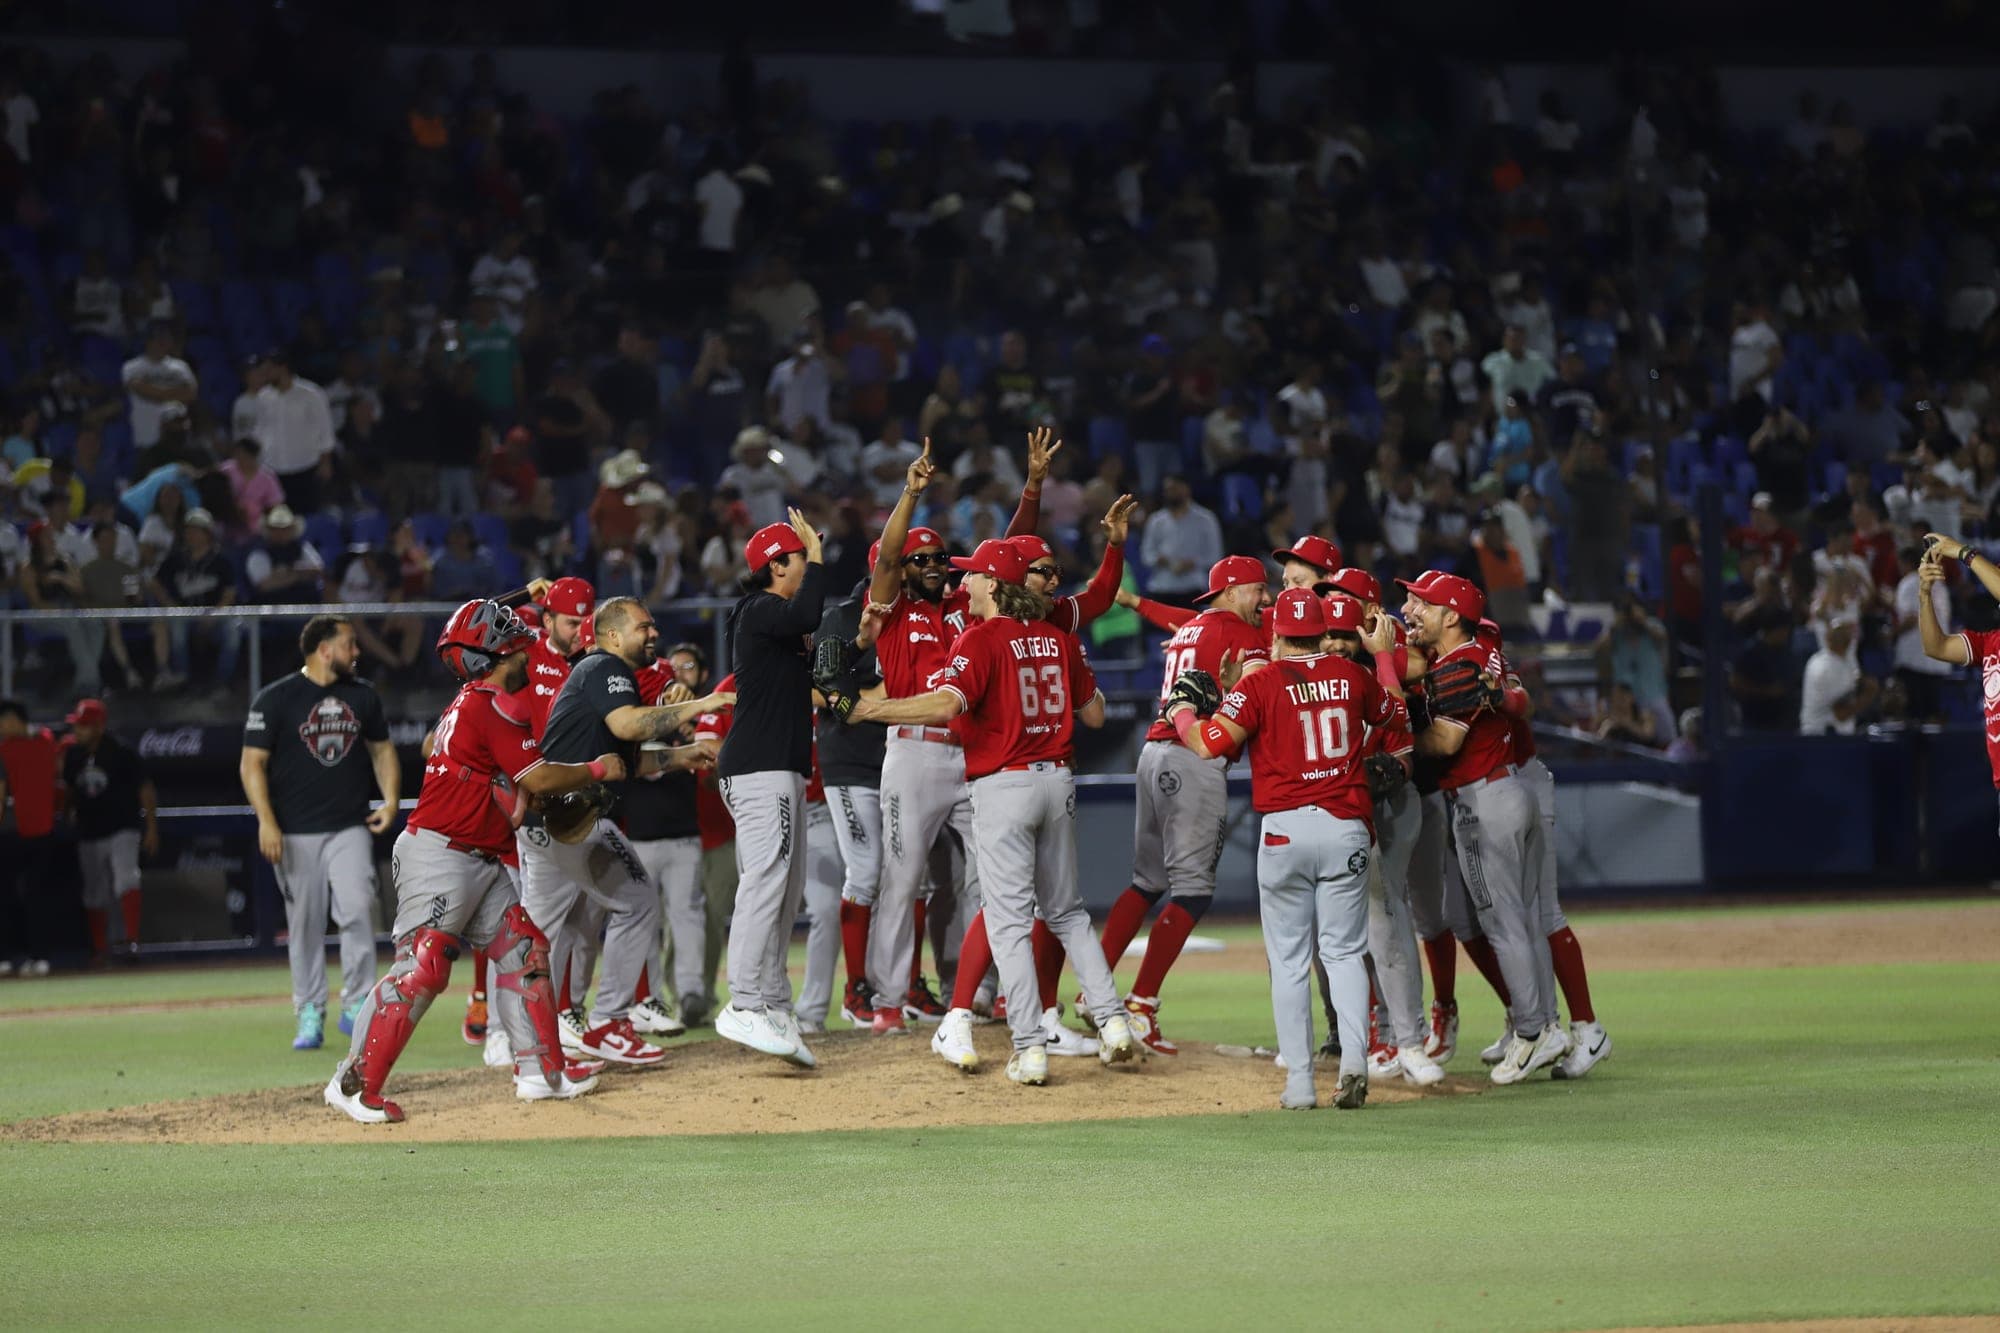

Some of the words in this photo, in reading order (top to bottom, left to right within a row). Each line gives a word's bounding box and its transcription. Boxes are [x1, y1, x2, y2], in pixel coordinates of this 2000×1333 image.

[1009, 638, 1029, 660] DE
[1028, 636, 1060, 658] GEUS
[1018, 665, 1066, 717] 63
[1285, 679, 1349, 705] TURNER
[1025, 723, 1051, 735] volaris
[1298, 707, 1350, 761] 10
[1302, 767, 1340, 781] volaris
[778, 795, 790, 862] AMSOIL
[889, 795, 902, 861] AMSOIL
